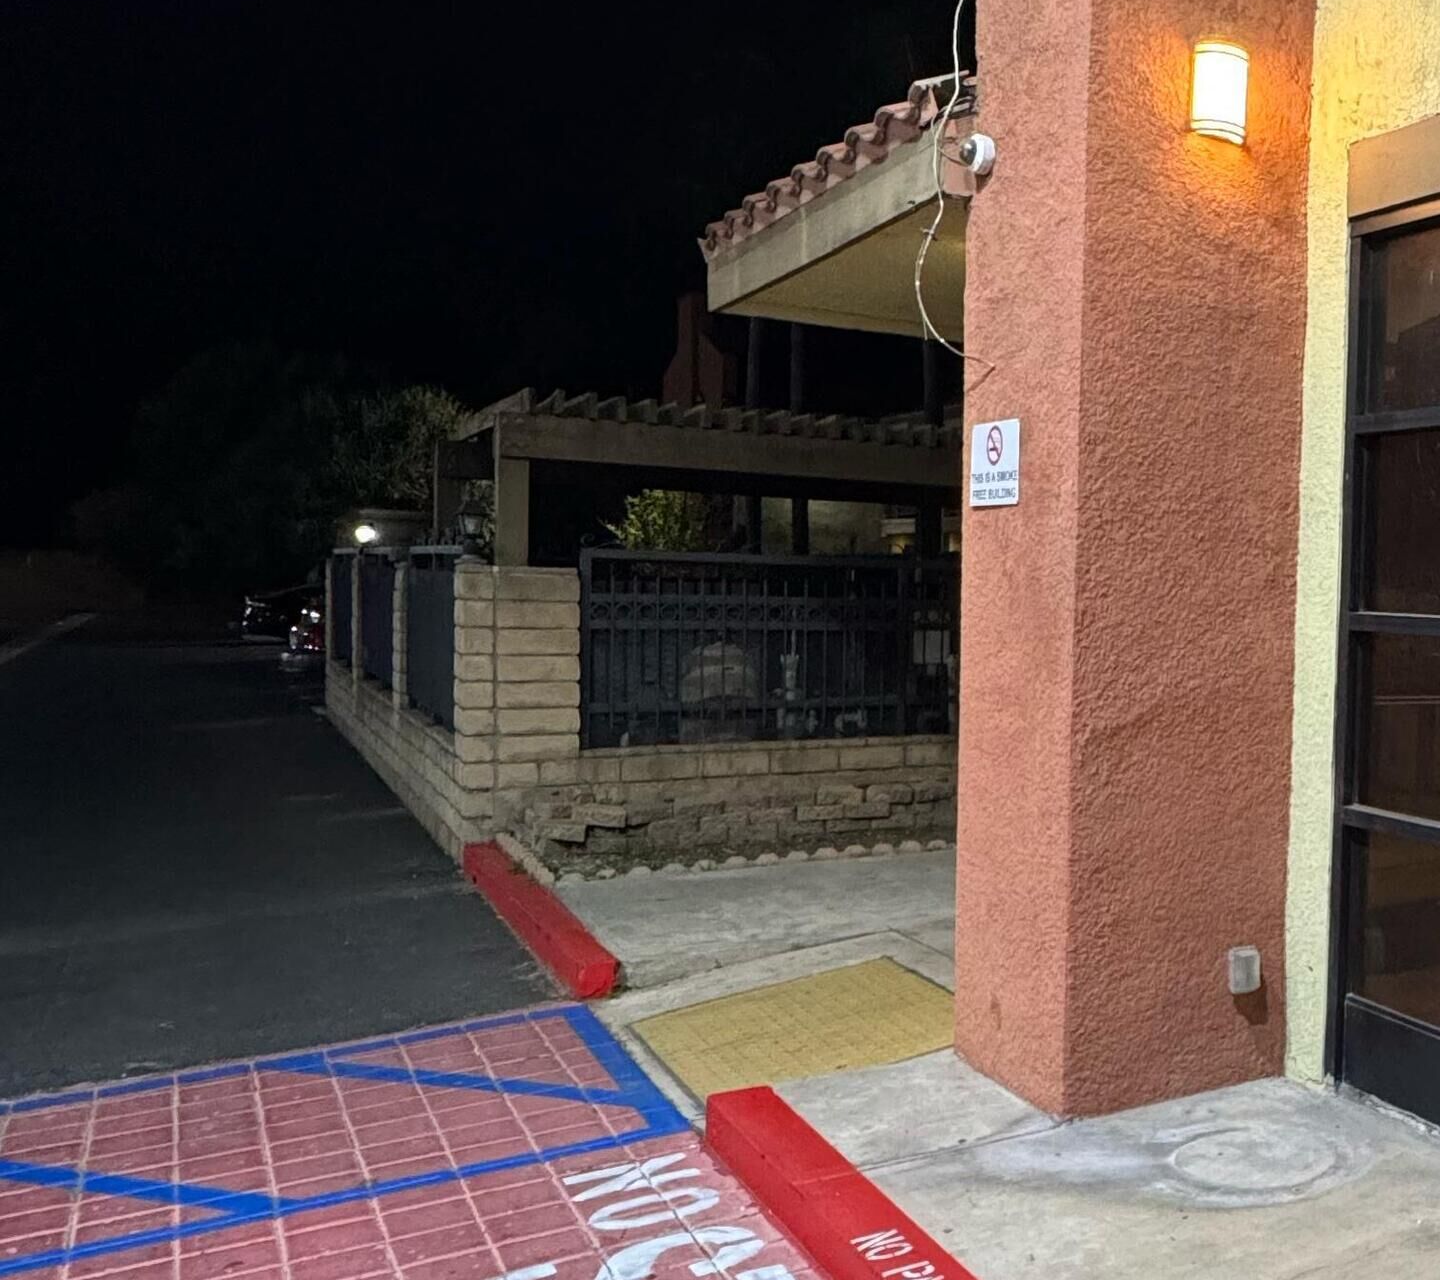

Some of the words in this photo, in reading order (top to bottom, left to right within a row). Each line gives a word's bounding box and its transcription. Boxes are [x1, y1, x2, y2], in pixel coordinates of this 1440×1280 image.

[972, 473, 984, 483] THIS
[985, 472, 990, 483] IS
[996, 470, 1017, 482] SMOKE
[973, 488, 986, 500] FREE
[988, 487, 1016, 499] BUILDING
[563, 1152, 721, 1231] NO
[850, 1228, 913, 1261] NO
